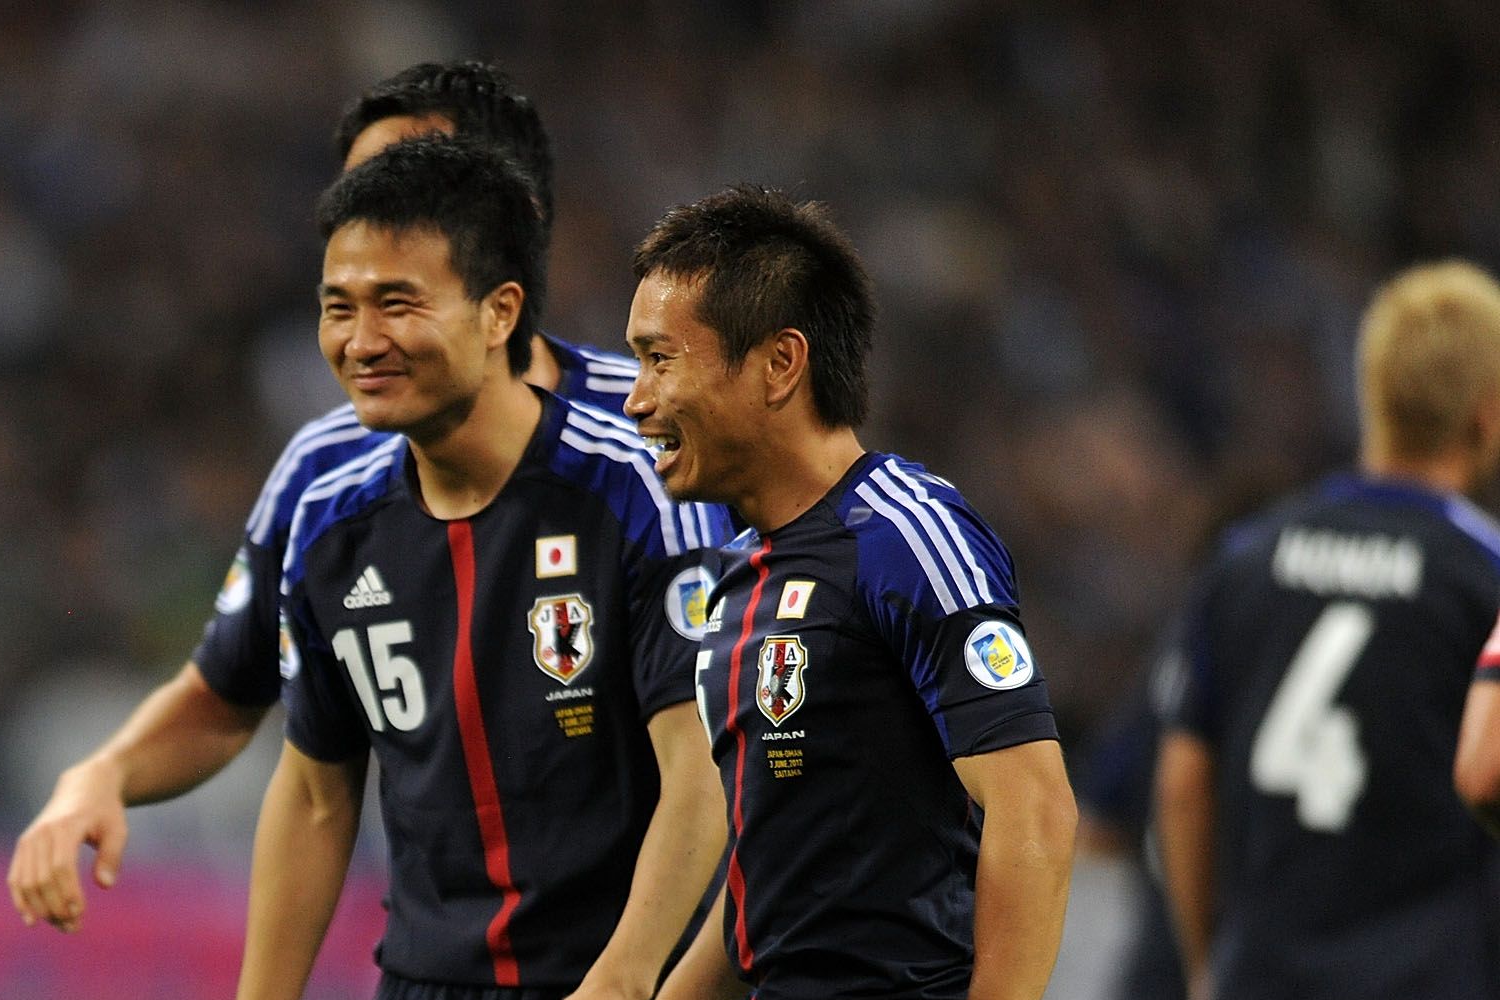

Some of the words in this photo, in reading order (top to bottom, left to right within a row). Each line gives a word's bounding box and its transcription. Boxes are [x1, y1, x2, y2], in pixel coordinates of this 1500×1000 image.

[343, 590, 393, 610] adidas
[332, 620, 426, 733] 15
[545, 687, 593, 702] JAPAN
[1252, 602, 1374, 831] 4
[761, 730, 805, 741] JAPAN
[767, 749, 803, 758] JAPAN-OMAN
[774, 769, 802, 778] SAITAMA
